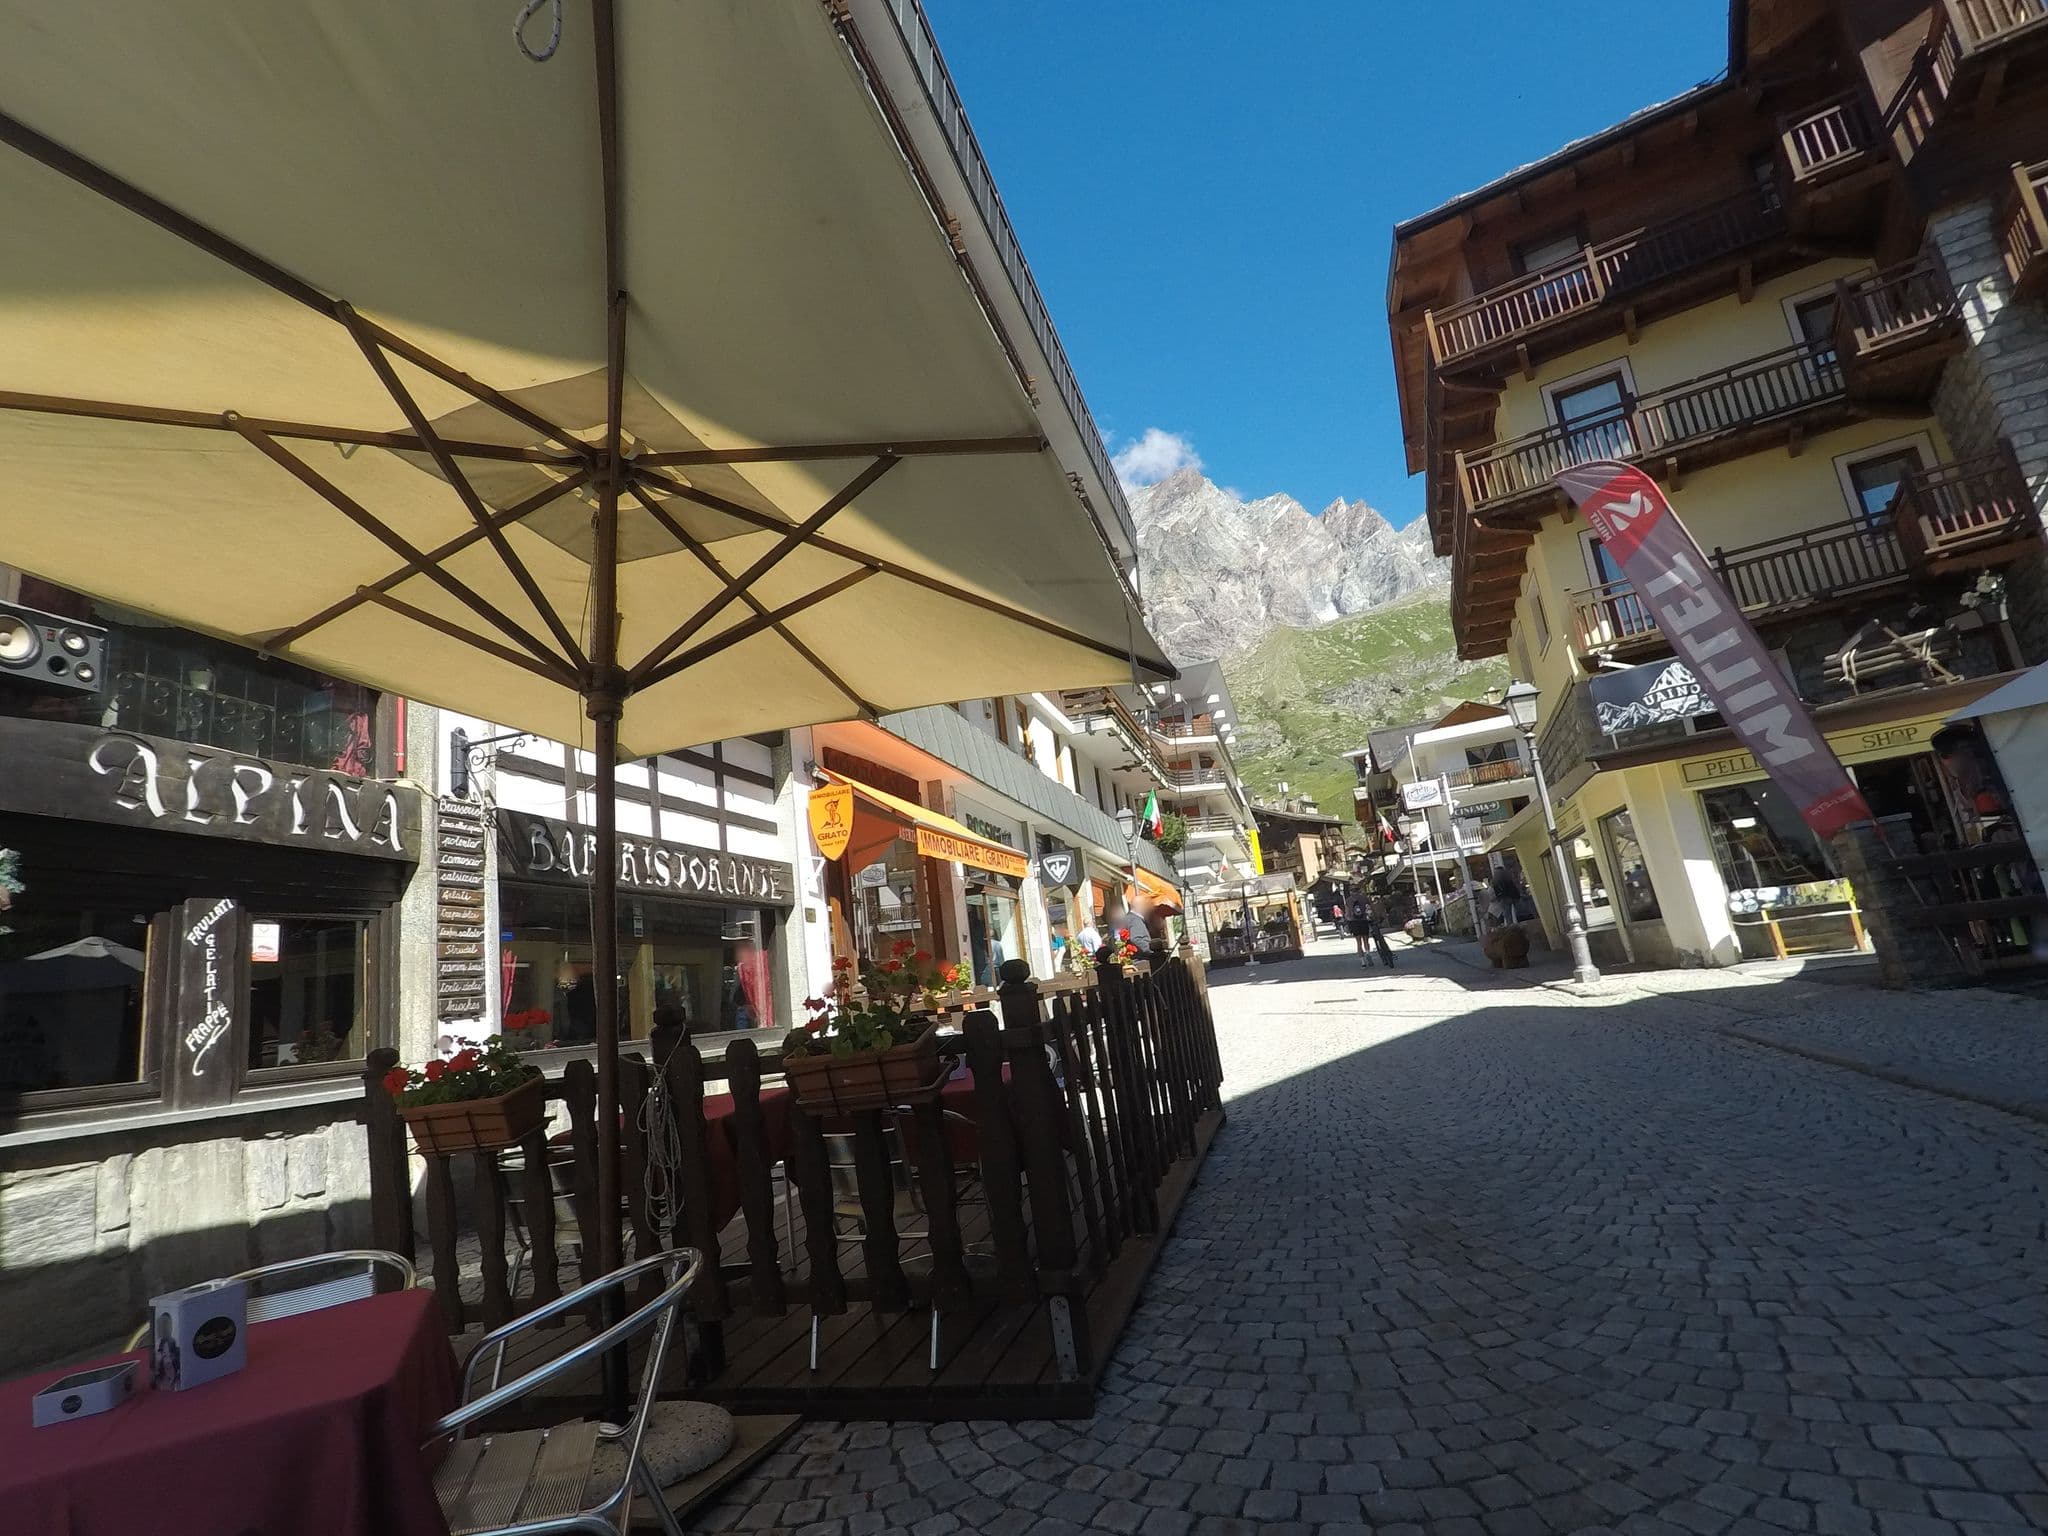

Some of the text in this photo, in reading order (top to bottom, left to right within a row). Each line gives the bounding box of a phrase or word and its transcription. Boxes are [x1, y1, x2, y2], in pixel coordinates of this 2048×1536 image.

[88, 731, 404, 852] ALPINA
[809, 788, 851, 800] IMMOBILIARE
[1454, 804, 1489, 816] CINEMA
[817, 829, 848, 841] GRATO
[919, 830, 982, 863] IMMOBILIARE
[985, 848, 1010, 870] GRATO
[620, 842, 785, 900] RISTORANTE
[186, 898, 235, 946] FRULLATI
[204, 933, 217, 1016] GELATI
